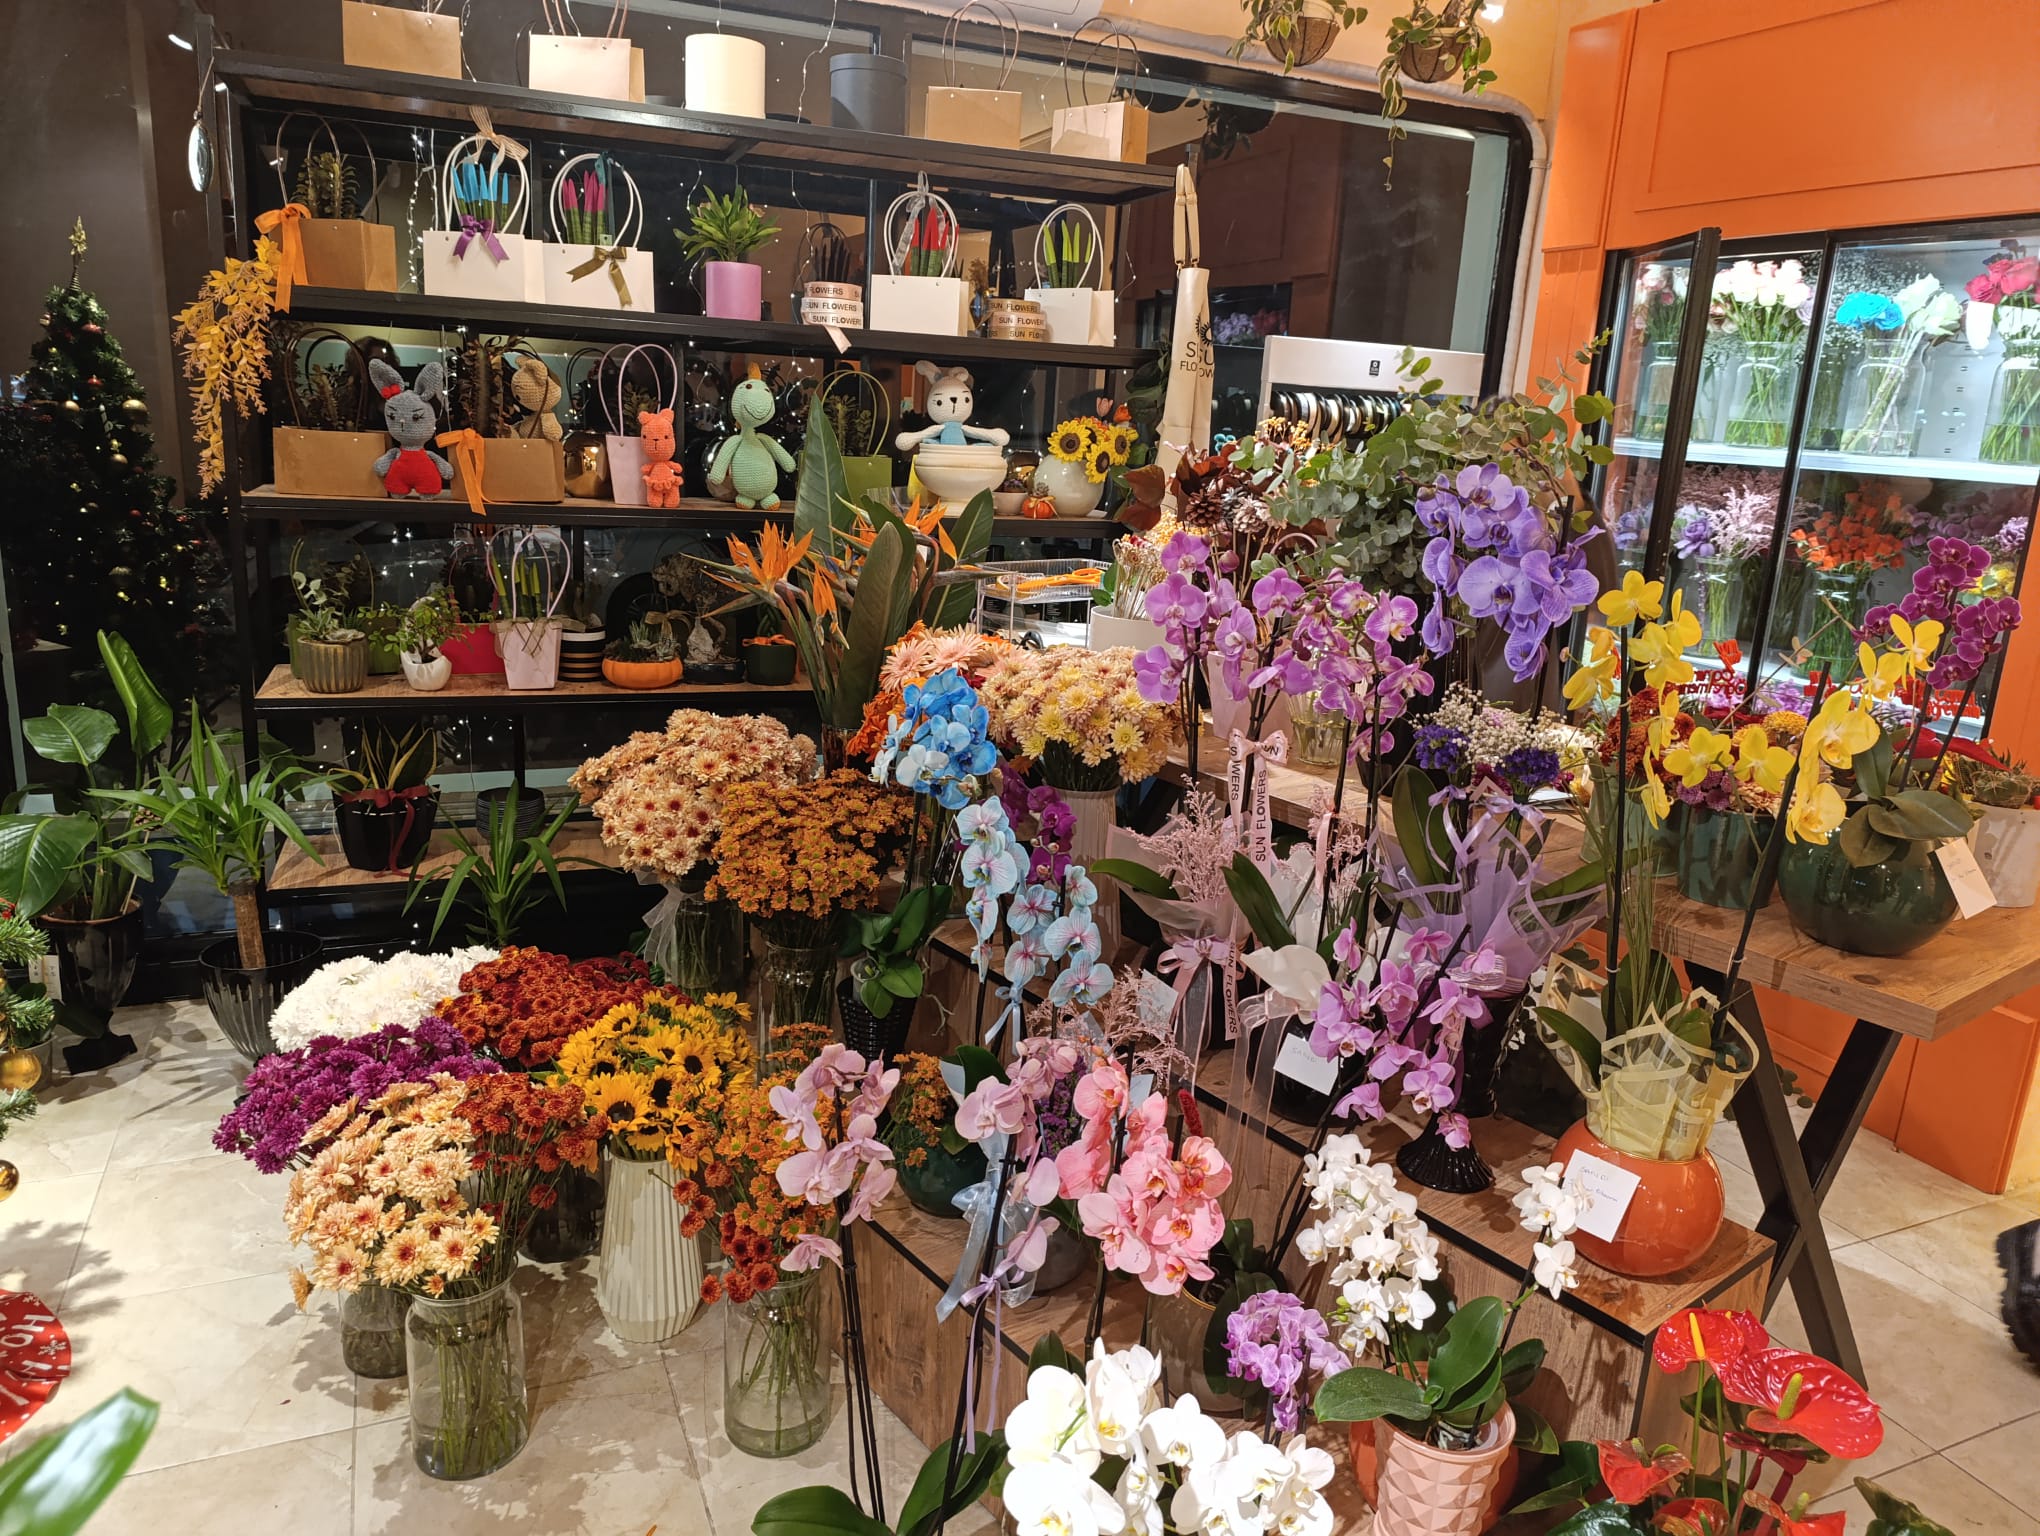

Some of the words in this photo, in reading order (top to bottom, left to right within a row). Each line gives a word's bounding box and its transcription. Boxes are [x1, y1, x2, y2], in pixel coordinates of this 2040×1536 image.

[822, 302, 857, 312] FLOWERS
[812, 315, 827, 323] SUN
[999, 316, 1014, 324] SUN
[1256, 769, 1267, 830] FLOWERS
[1255, 836, 1266, 862] SUN
[1225, 974, 1238, 1034] FLOWERS
